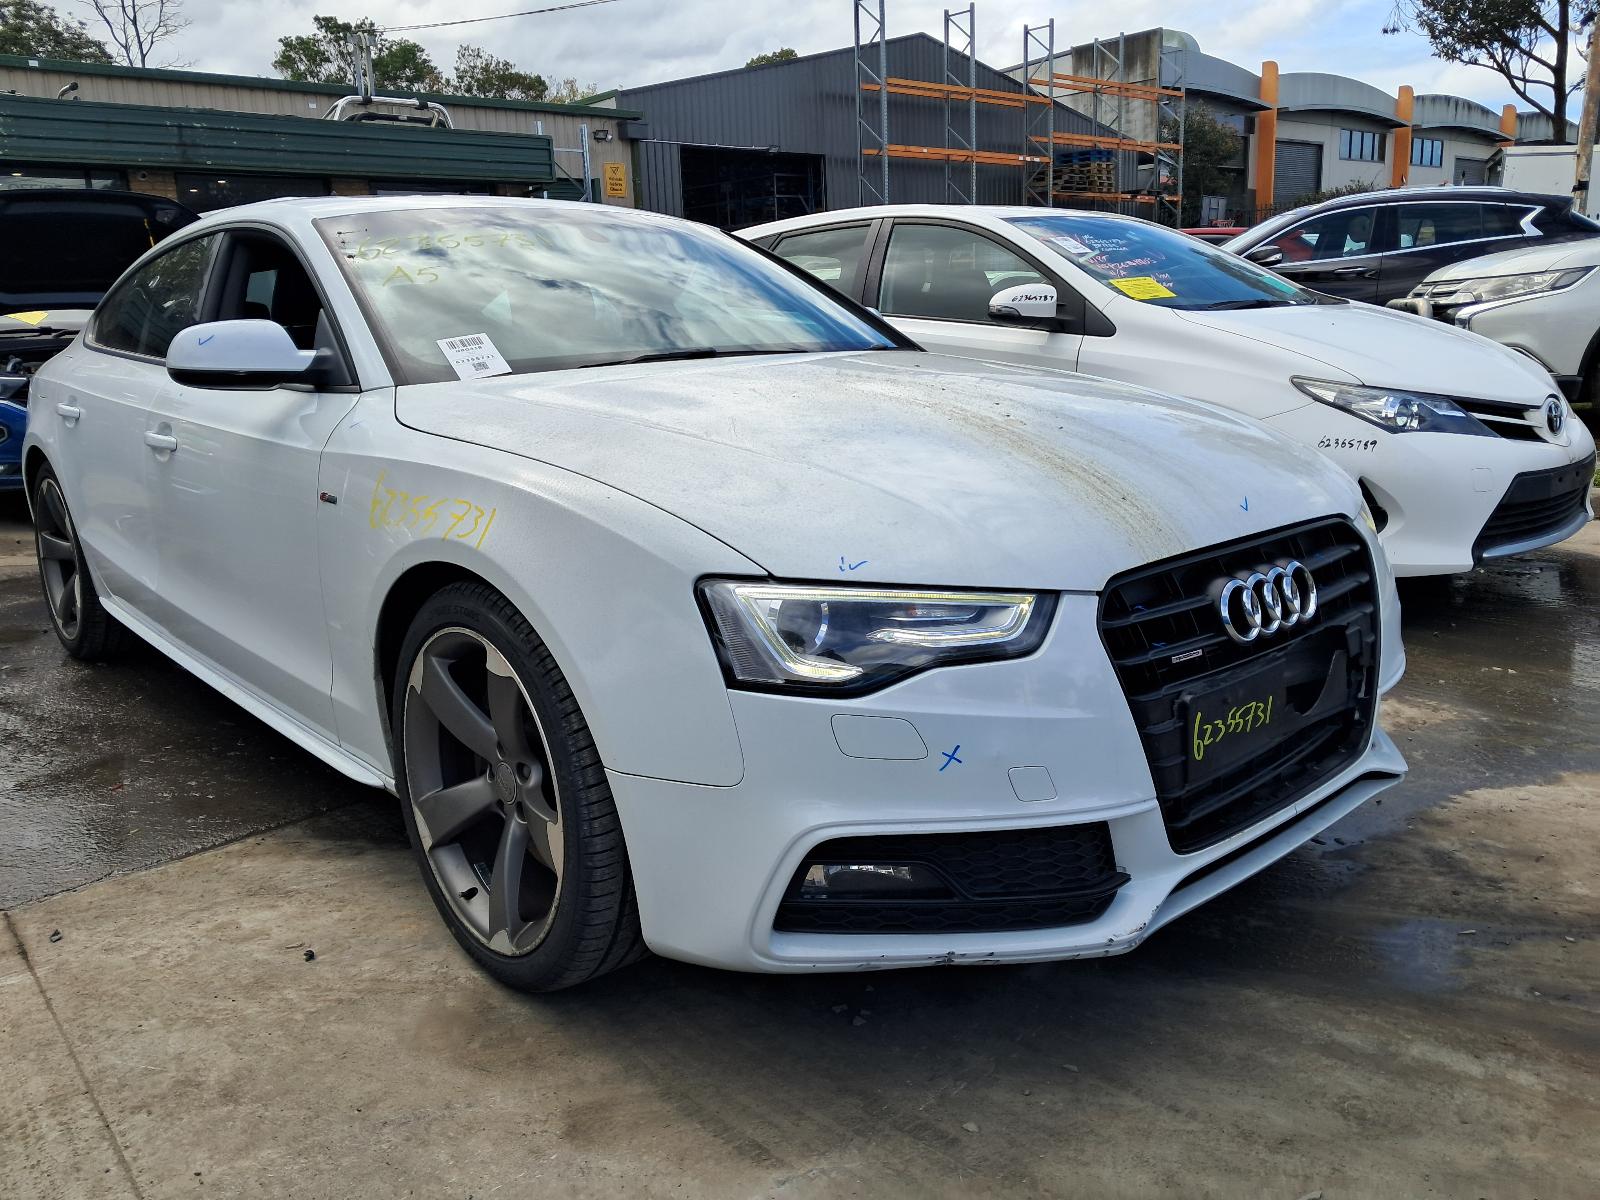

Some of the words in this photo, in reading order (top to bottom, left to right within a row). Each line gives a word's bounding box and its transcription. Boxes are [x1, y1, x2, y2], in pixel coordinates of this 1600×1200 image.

[382, 265, 441, 288] A5
[1317, 434, 1378, 452] 62365789
[1193, 695, 1273, 761] 62355731
